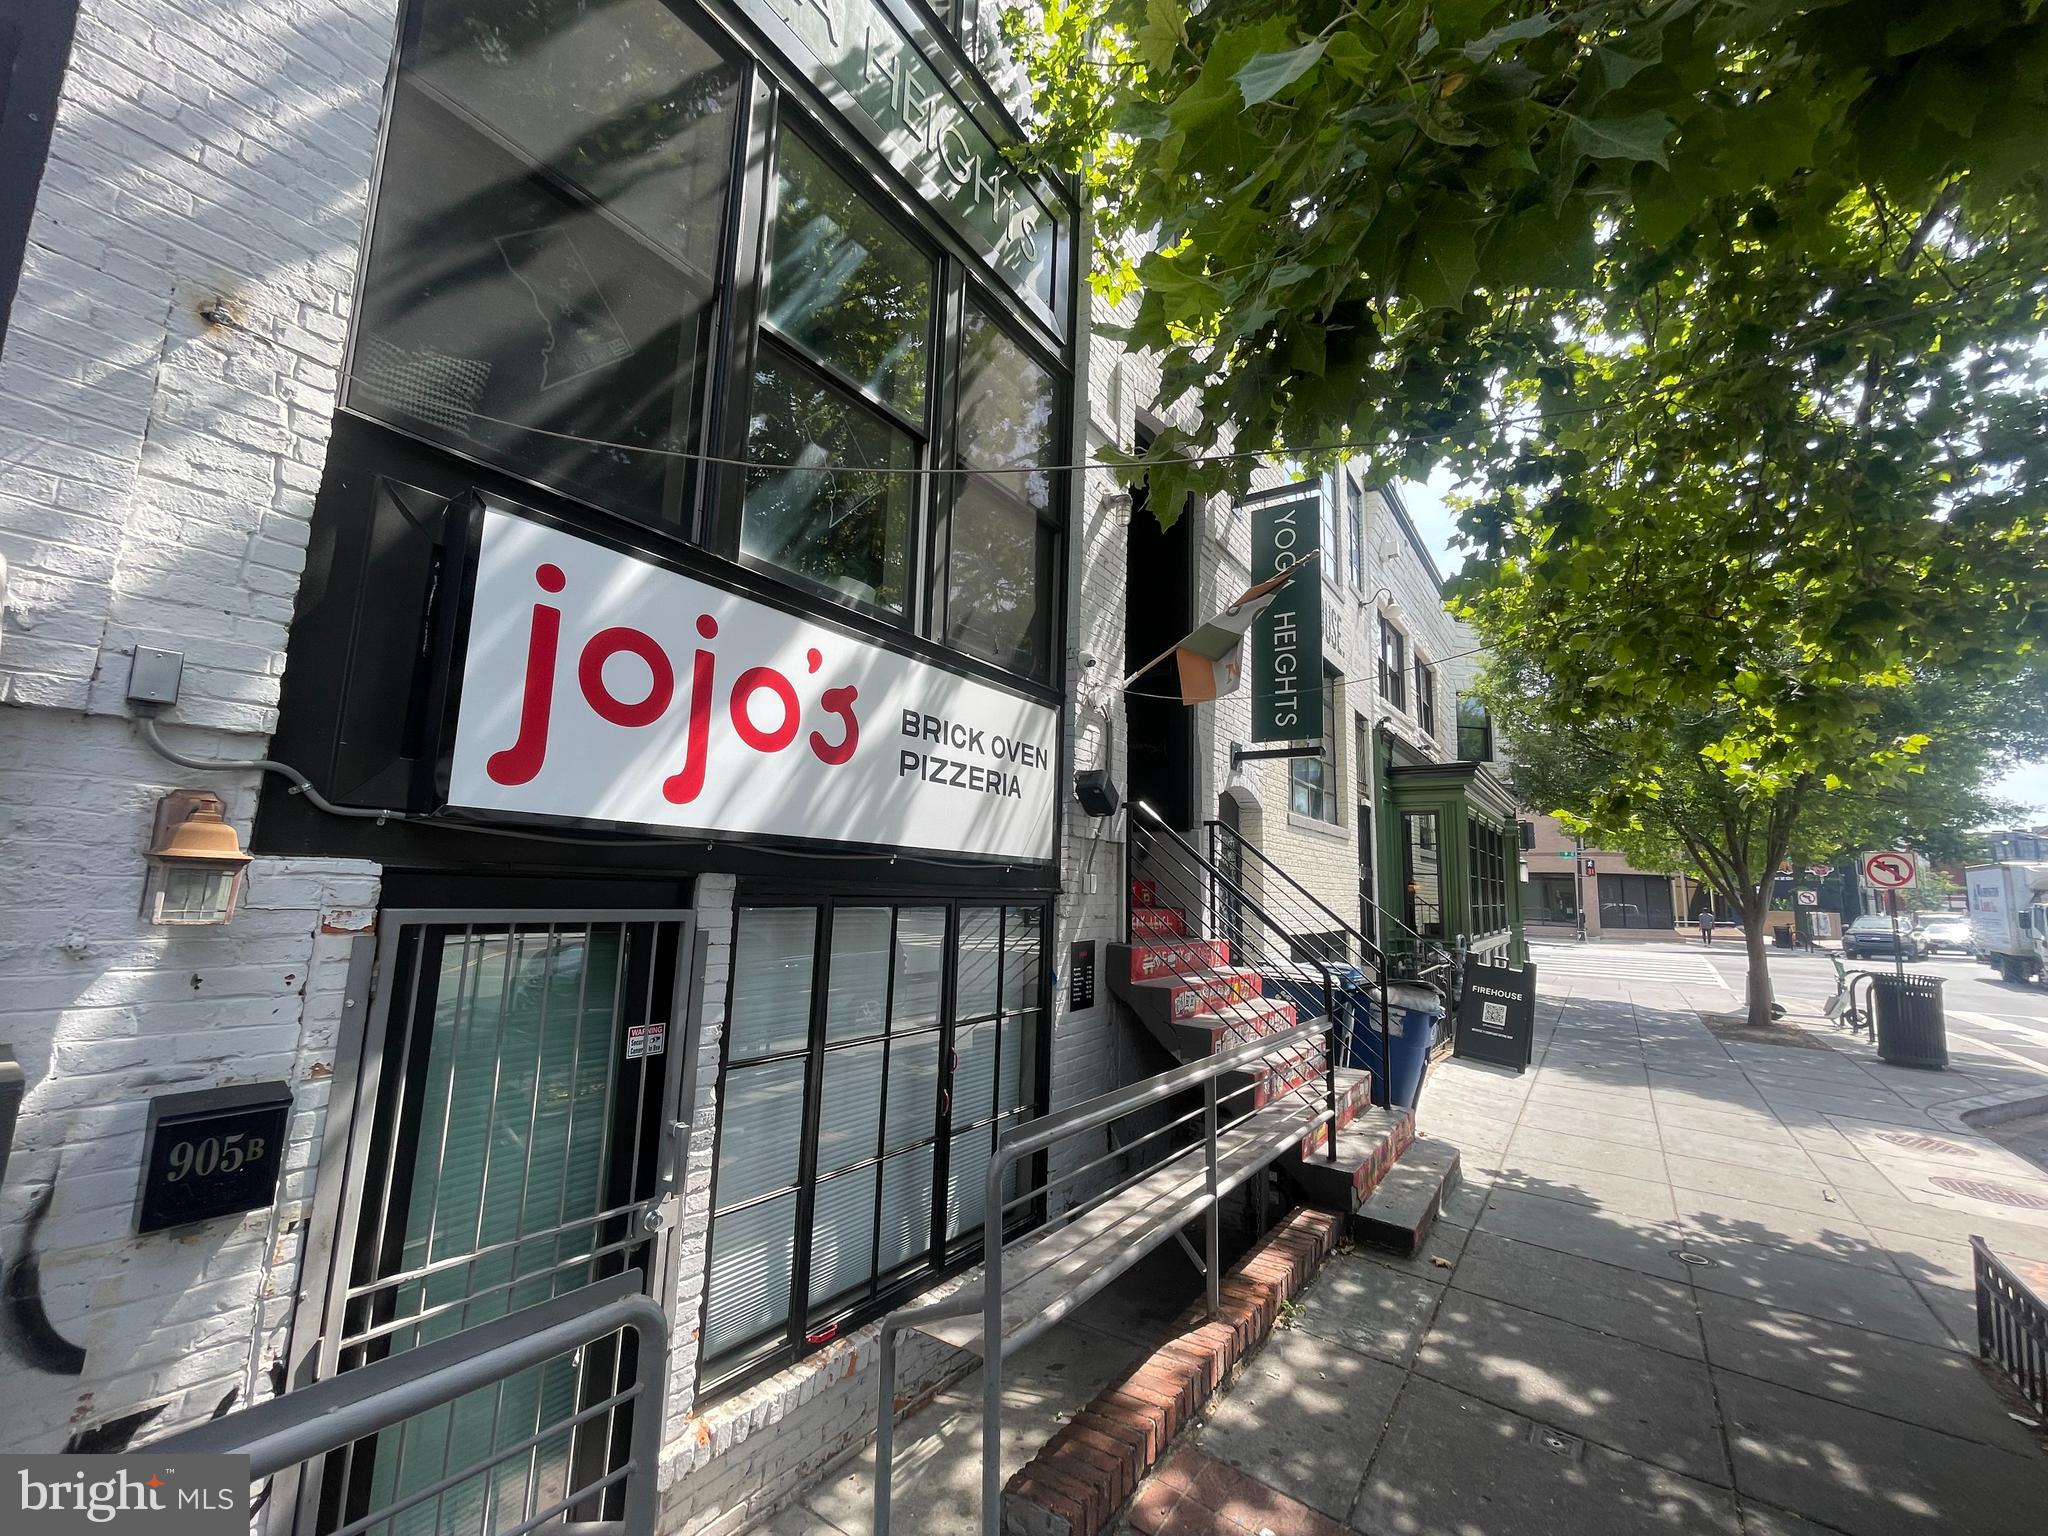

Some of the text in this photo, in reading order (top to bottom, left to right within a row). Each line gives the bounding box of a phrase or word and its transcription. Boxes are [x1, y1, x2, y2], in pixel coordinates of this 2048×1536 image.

[1273, 508, 1298, 728] YOG HEIGHTS
[901, 708, 1048, 771] BRICK OVEN
[899, 749, 1022, 799] PIZZERIA
[1472, 985, 1523, 1001] FIREHOUSE
